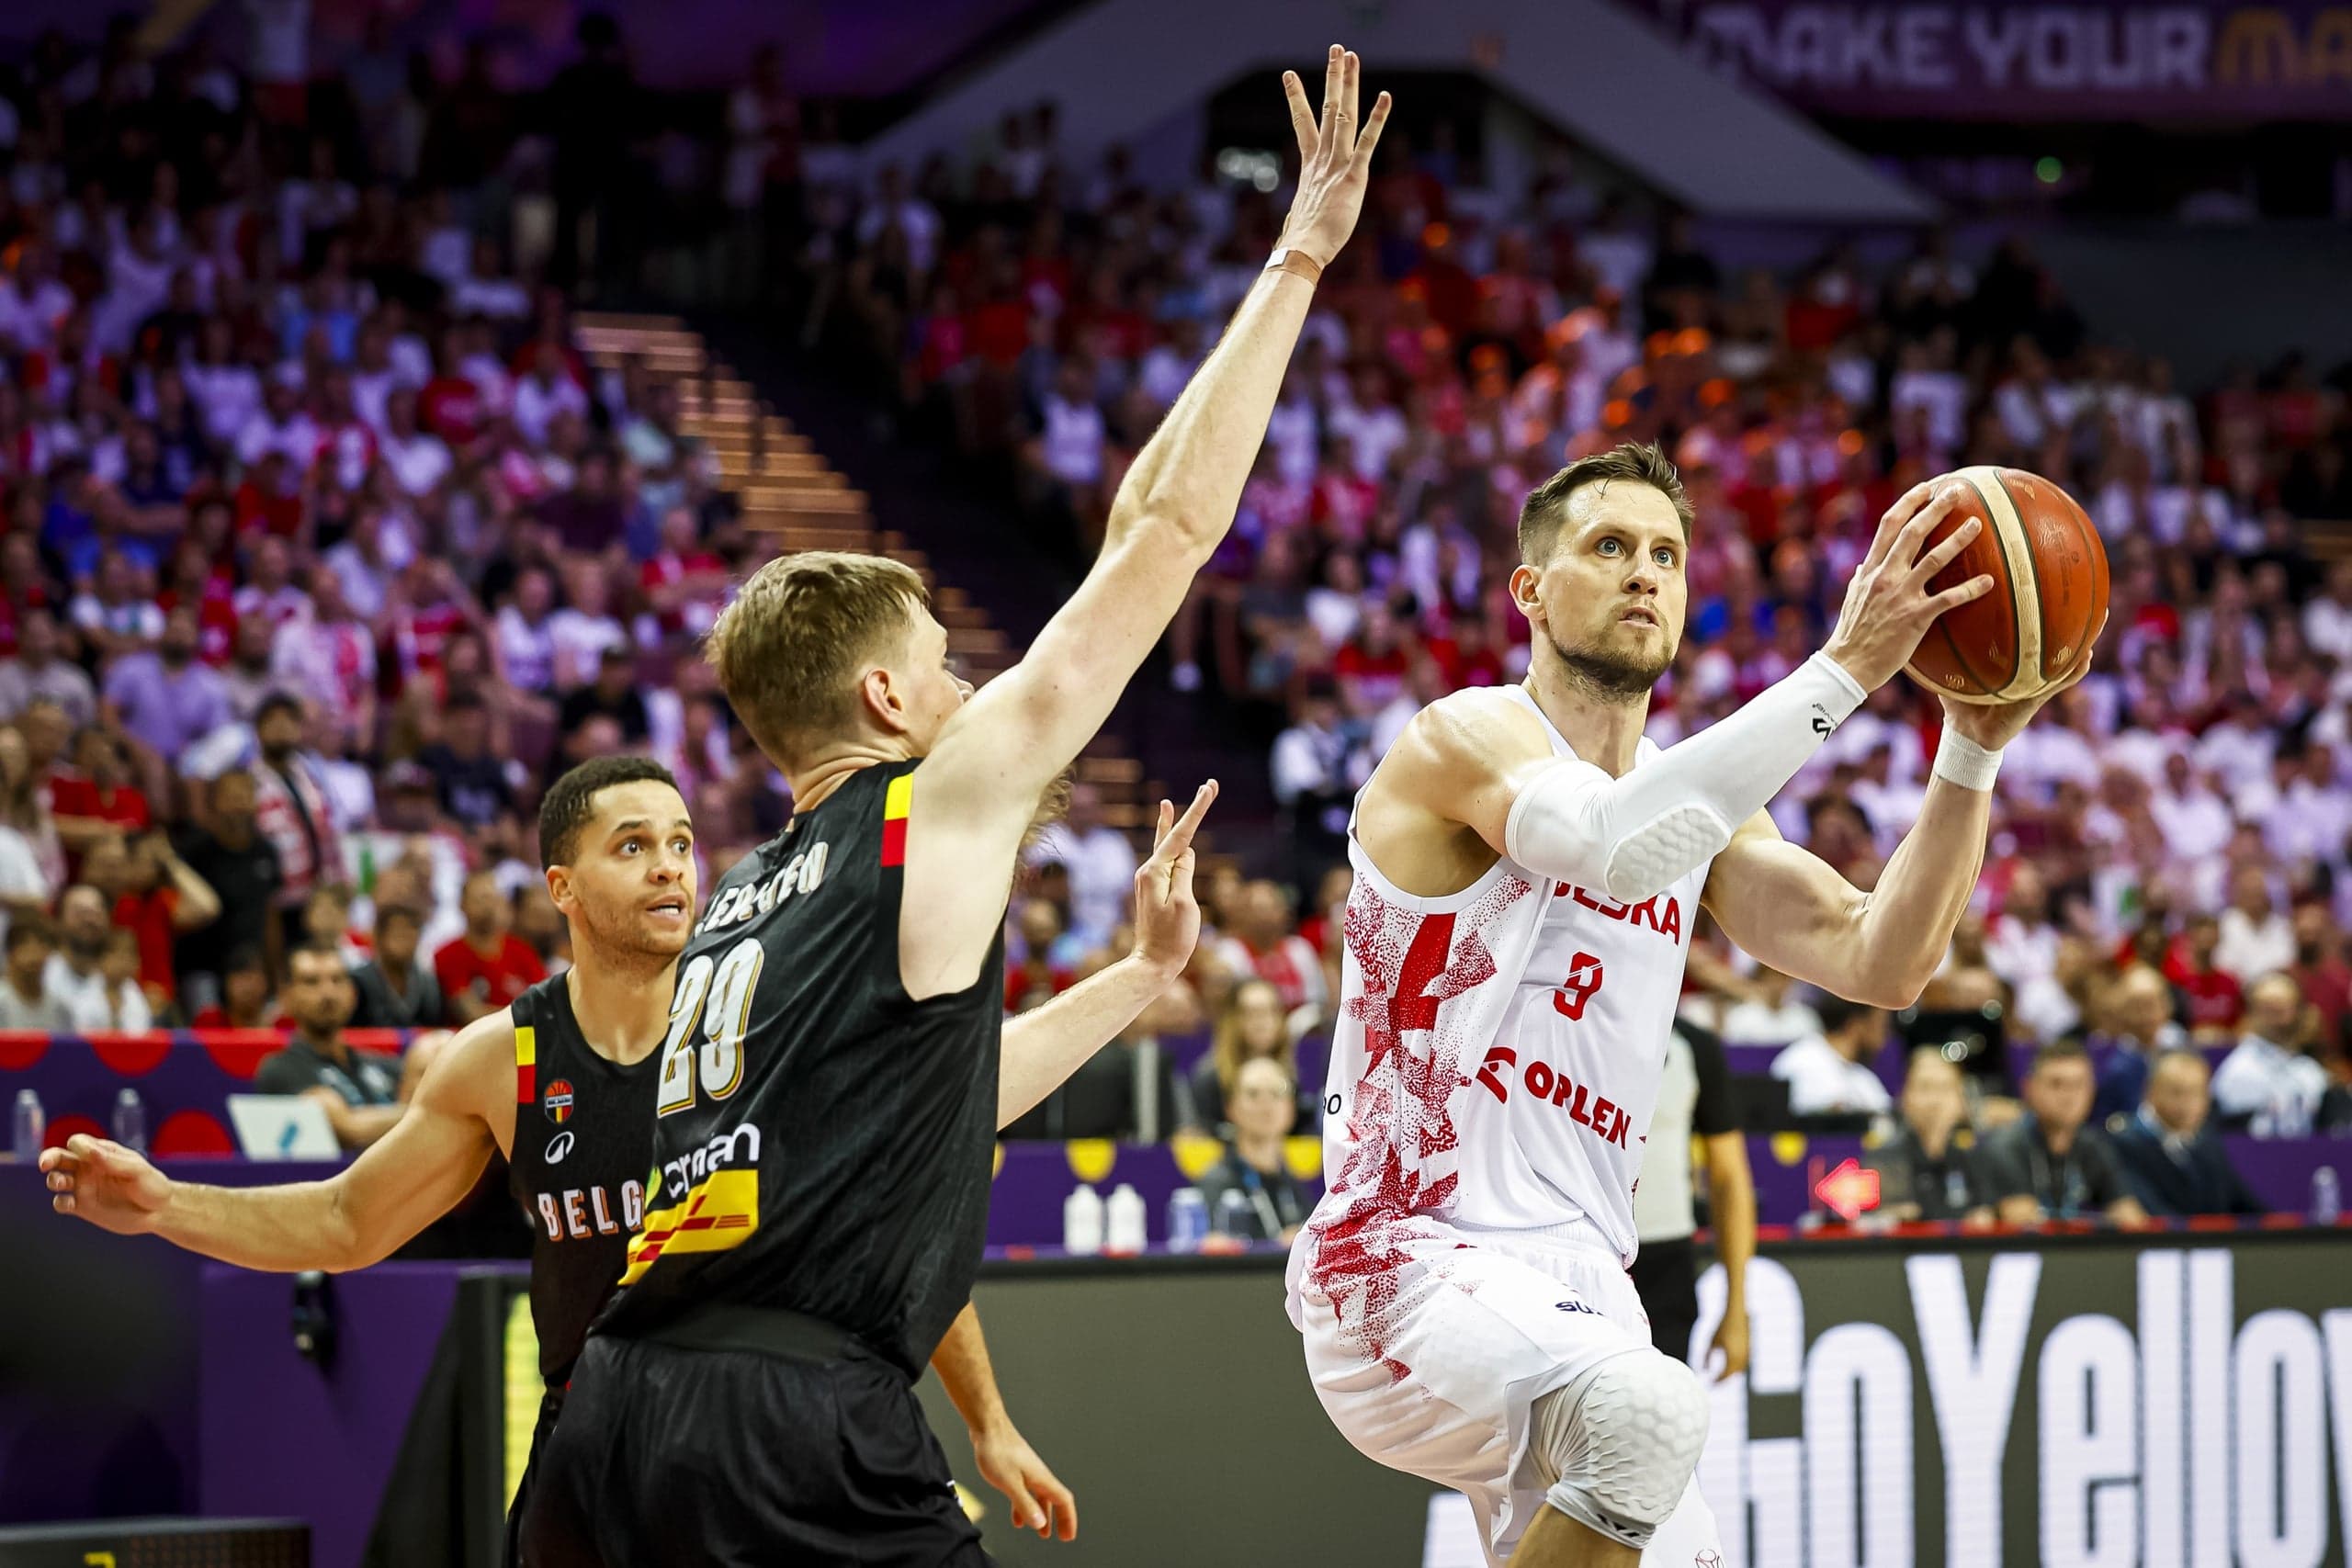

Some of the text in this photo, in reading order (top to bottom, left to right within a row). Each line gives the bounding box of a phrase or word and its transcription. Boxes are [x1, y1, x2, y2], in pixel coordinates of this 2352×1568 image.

[1964, 11, 2207, 89] YOUR
[657, 937, 764, 1119] 29
[1553, 951, 1604, 1021] 9
[1524, 1061, 1632, 1151] ORLEN
[537, 1179, 645, 1241] BELG
[1689, 1248, 2352, 1568] GoYello
